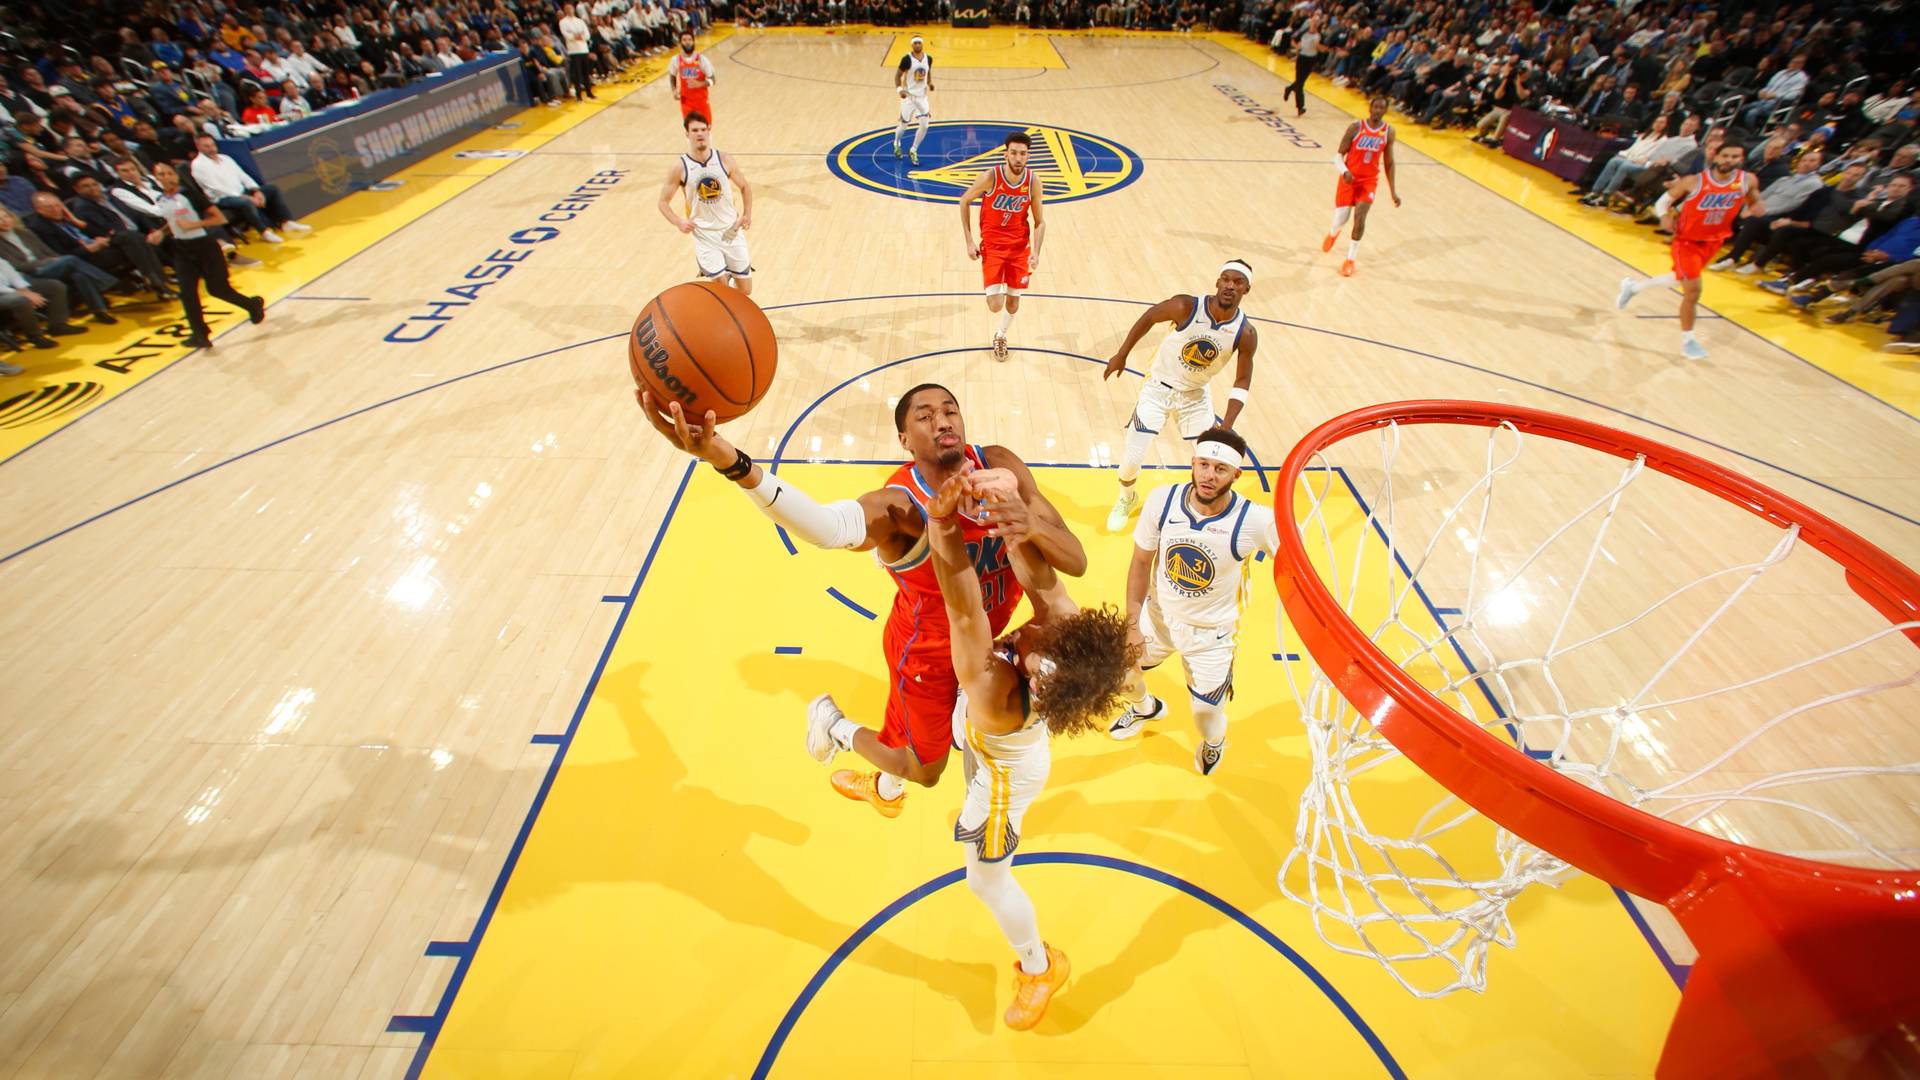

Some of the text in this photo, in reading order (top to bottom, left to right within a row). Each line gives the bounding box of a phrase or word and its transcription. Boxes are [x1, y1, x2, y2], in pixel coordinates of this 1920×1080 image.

[1356, 134, 1384, 152] OKC
[992, 193, 1029, 213] OKC
[1696, 190, 1745, 211] OKC
[1000, 212, 1012, 226] 7
[383, 169, 631, 342] CHASE CENTER
[636, 312, 698, 404] Wilson
[1204, 348, 1215, 358] 10
[1199, 542, 1219, 561] STATE
[1193, 558, 1207, 574] 31
[1163, 570, 1214, 599] WARRIORS
